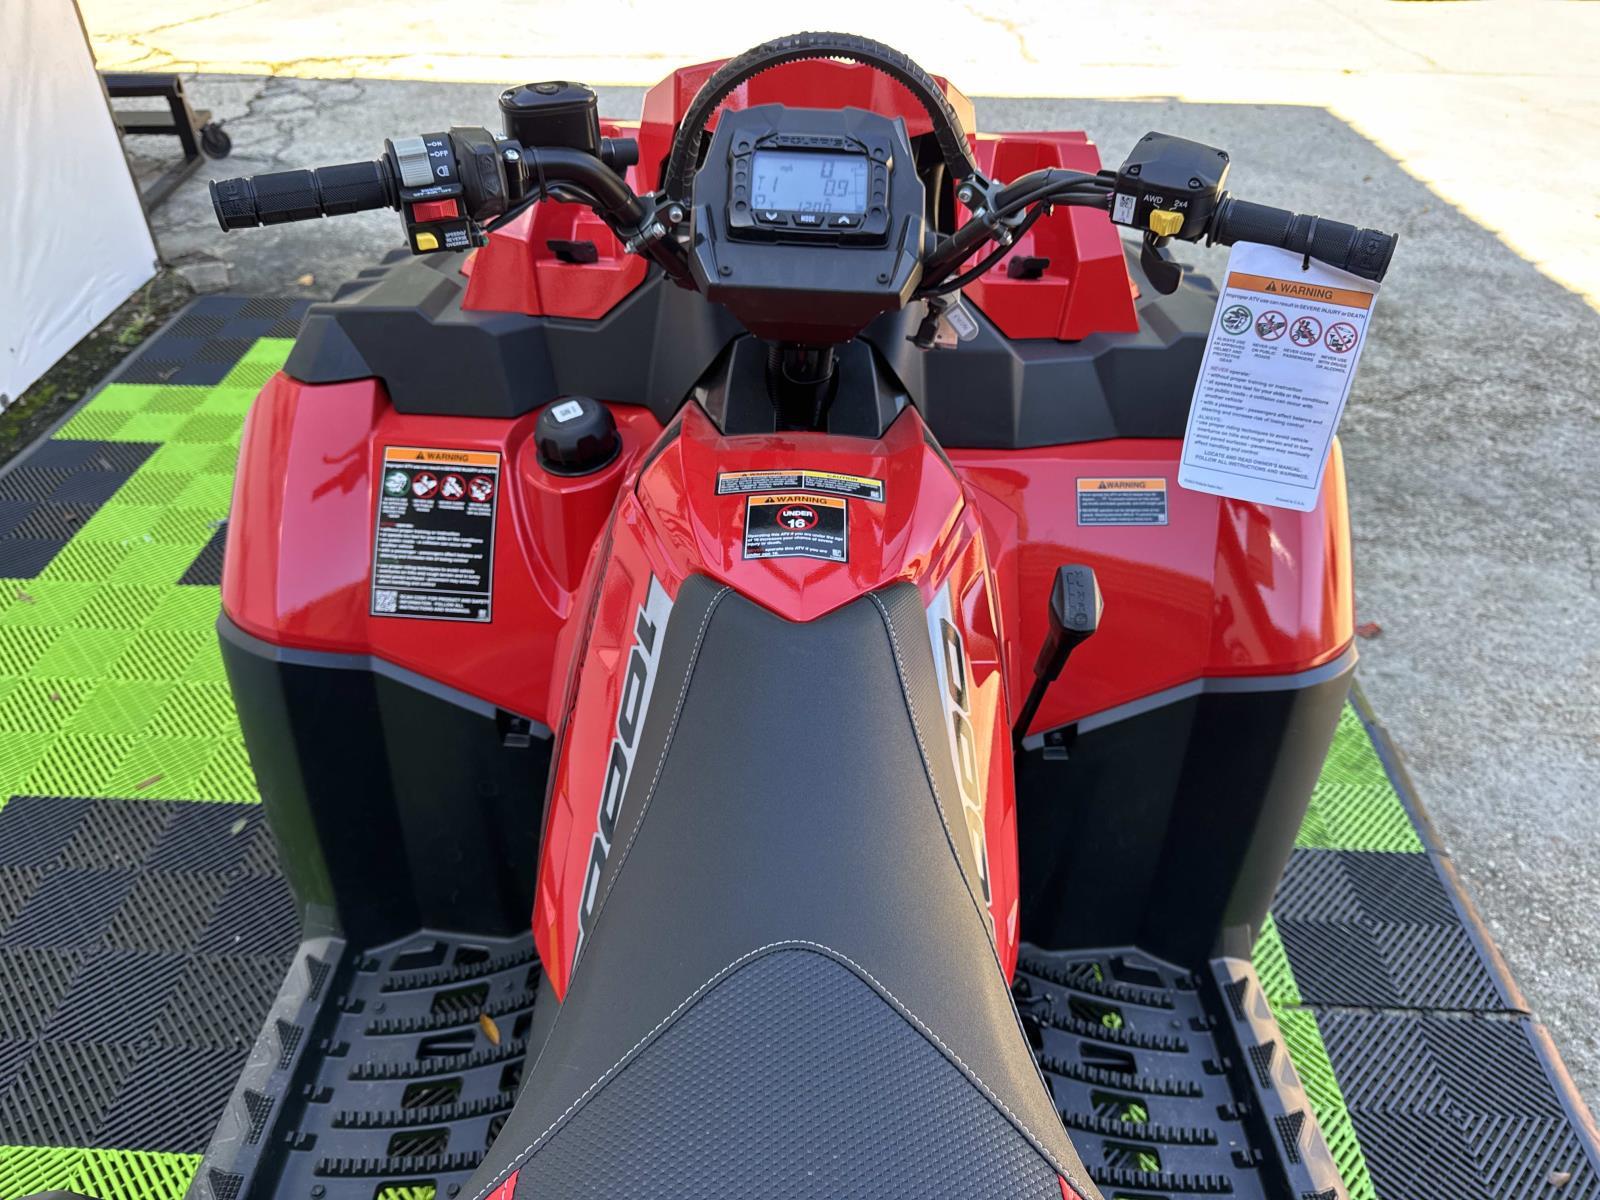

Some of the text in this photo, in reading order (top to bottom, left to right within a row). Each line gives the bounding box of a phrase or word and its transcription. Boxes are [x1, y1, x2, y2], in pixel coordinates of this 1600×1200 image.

[820, 161, 834, 178] 0
[1143, 194, 1163, 204] AWD
[1174, 200, 1188, 208] 2x4
[1279, 283, 1334, 300] WARNING
[1299, 304, 1320, 312] SEVERE
[1320, 307, 1341, 315] INJURY
[1346, 311, 1365, 319] DEATH
[1301, 396, 1329, 404] conditions
[427, 452, 470, 463] WARNING
[1106, 481, 1146, 489] WARNING
[776, 496, 827, 505] WARNING
[788, 518, 805, 528] 16
